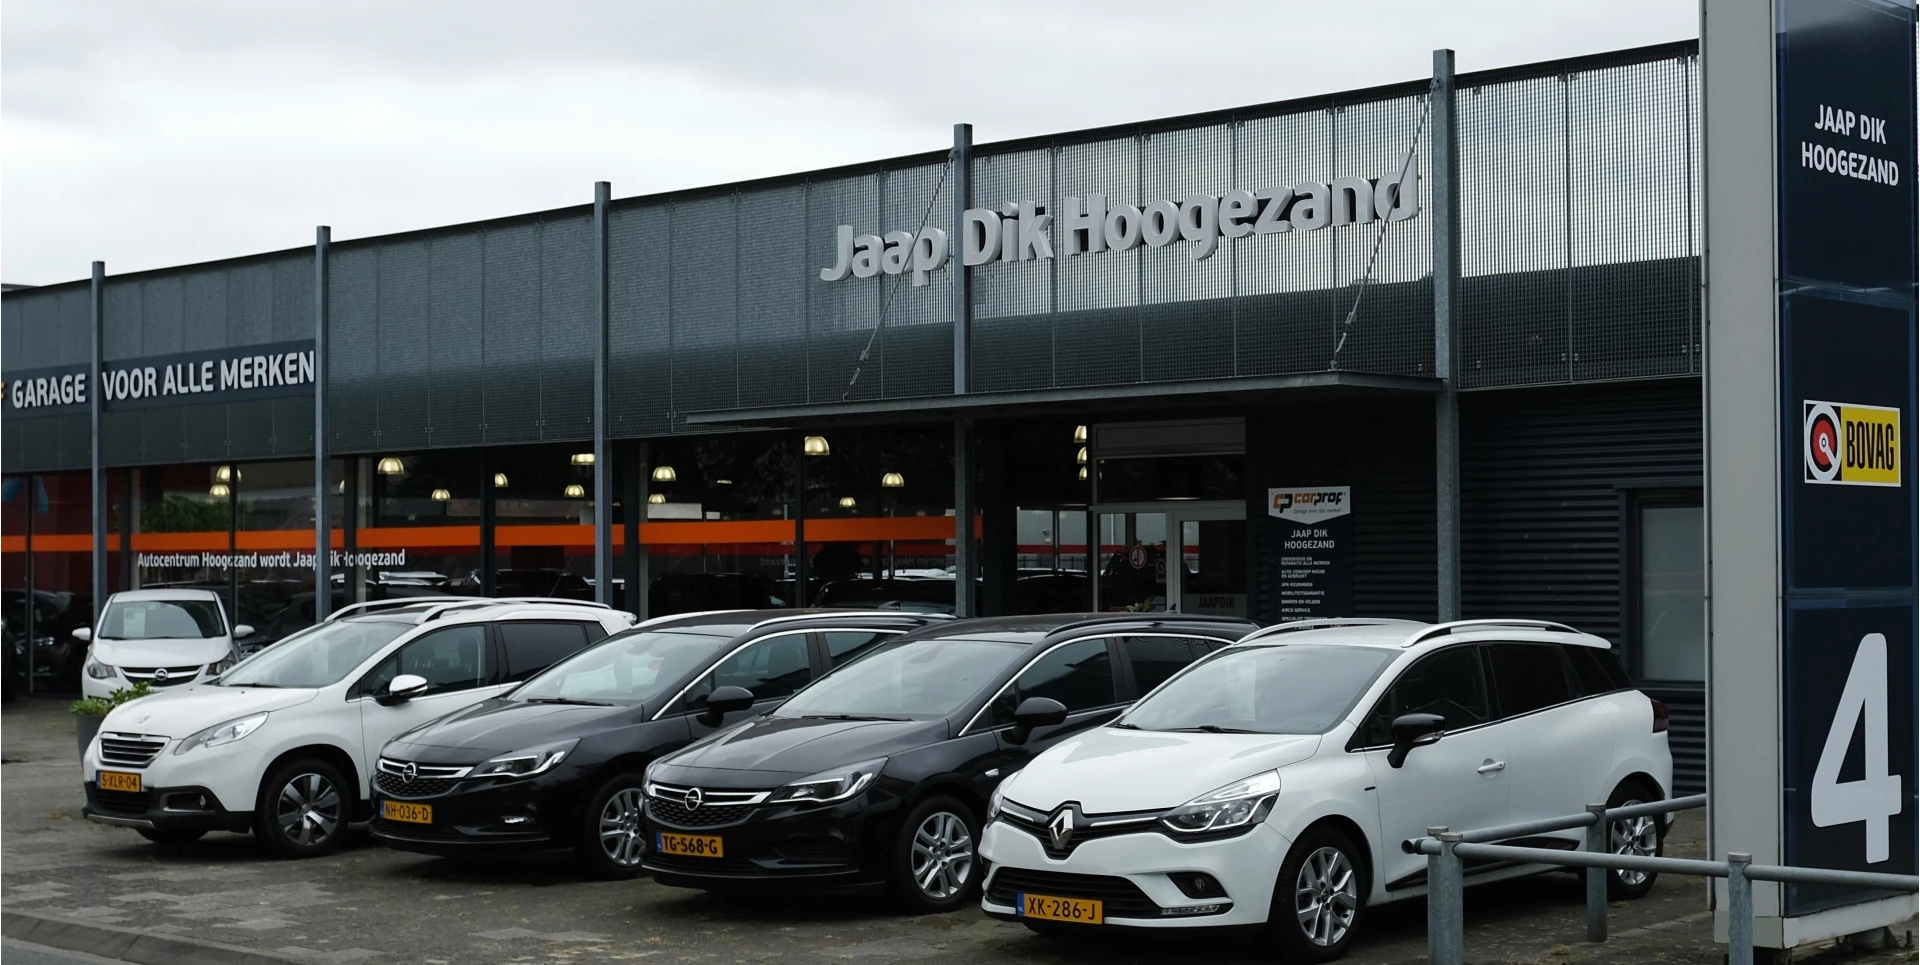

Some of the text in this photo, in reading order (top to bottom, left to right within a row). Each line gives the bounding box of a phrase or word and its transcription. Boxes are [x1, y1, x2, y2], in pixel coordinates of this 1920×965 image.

[1814, 104, 1887, 145] JAAP DIK
[1802, 141, 1899, 187] HOOGEZAND
[820, 152, 1419, 287] Jaap Dik Hoogezand
[12, 373, 86, 409] GARAGE
[102, 366, 157, 401] VOOR
[163, 360, 214, 396] ALLE
[220, 350, 315, 391] MERKEN
[1846, 420, 1895, 471] BOVAG
[1284, 540, 1335, 549] HOOGEZAND
[1291, 529, 1328, 538] JAAP DIK
[138, 552, 200, 568] Autocentrum
[260, 551, 291, 567] wordt
[1811, 632, 1902, 864] 4
[102, 774, 138, 789] 5-XLR-04
[385, 803, 429, 821] NH-036-D
[662, 835, 718, 855] TG-568-G
[1028, 896, 1096, 920] XK-286-J
